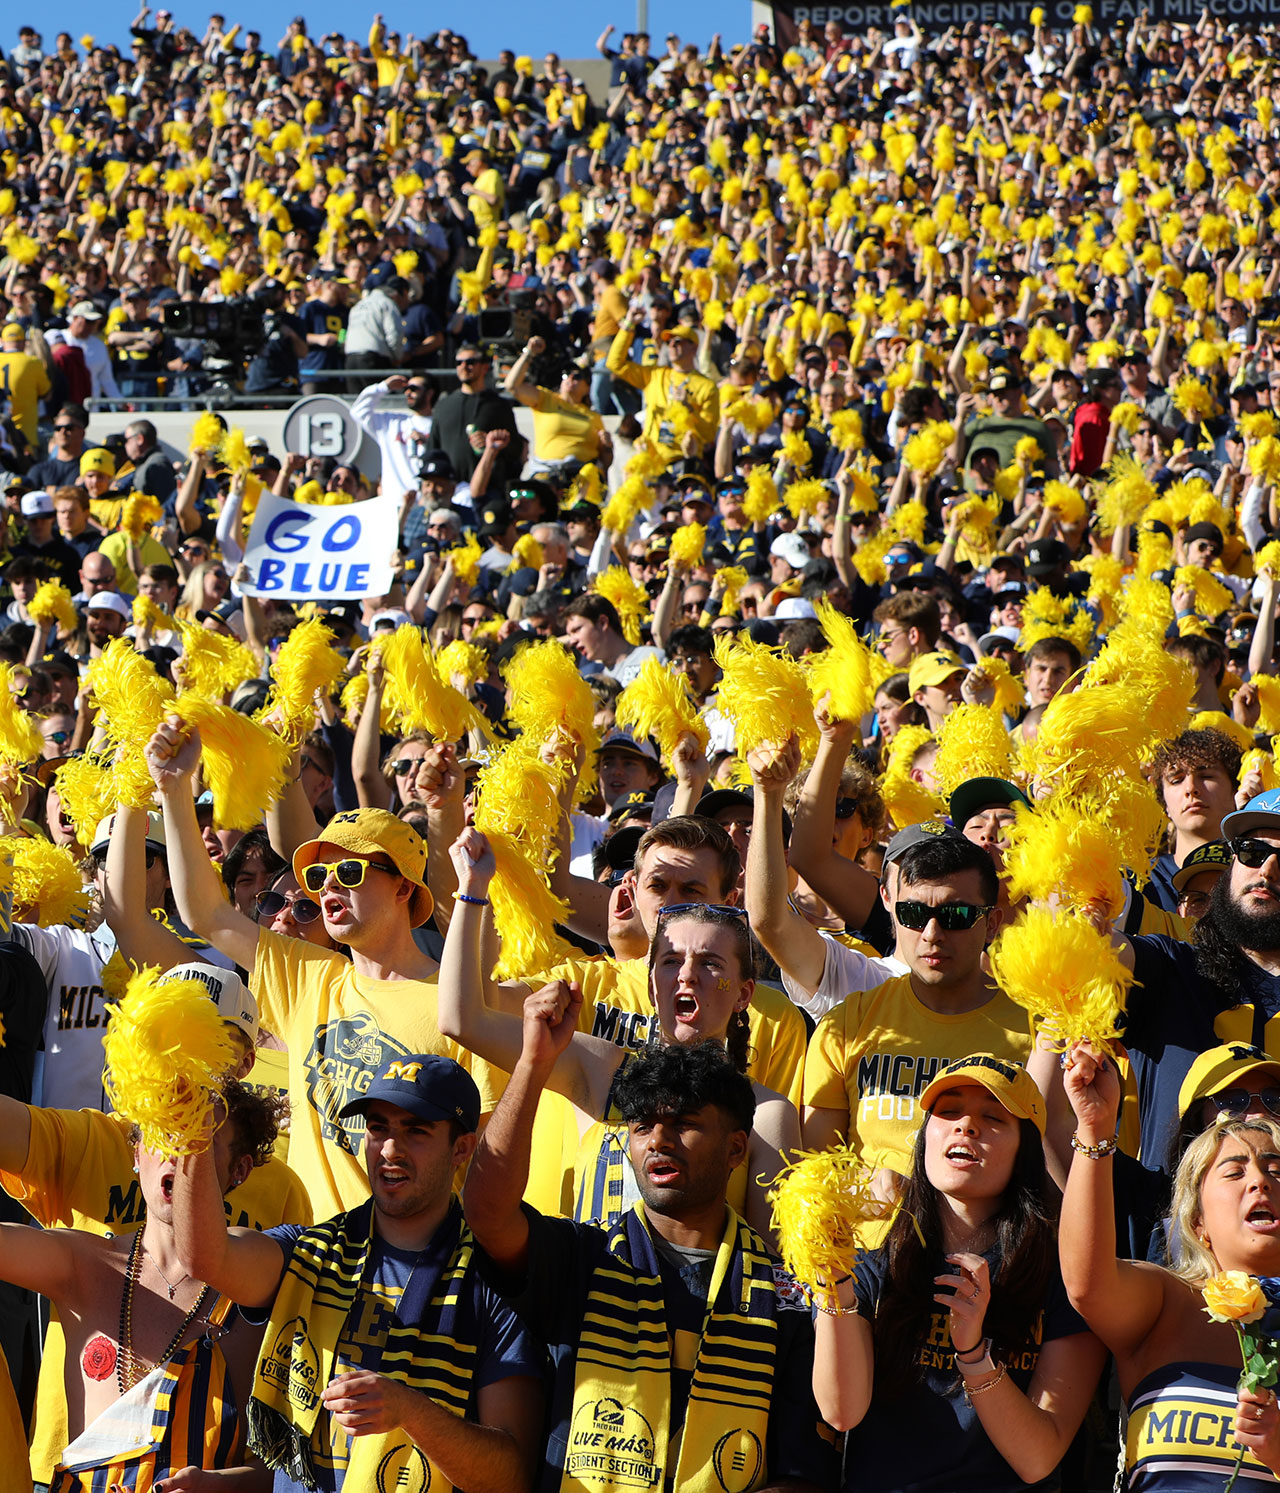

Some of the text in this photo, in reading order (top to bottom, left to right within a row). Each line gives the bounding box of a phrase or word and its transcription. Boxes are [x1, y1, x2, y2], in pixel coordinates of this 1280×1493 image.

[794, 5, 895, 25] REPORT
[1056, 1, 1093, 20] O
[1101, 0, 1154, 18] FAN
[298, 412, 344, 457] 13
[265, 510, 362, 553] GO
[256, 558, 371, 592] BLUE
[626, 793, 645, 804] M
[335, 813, 360, 823] M
[718, 978, 731, 991] M
[382, 1061, 424, 1083] M
[945, 1055, 1019, 1084] MICHIGAN
[862, 1094, 915, 1122] FOO
[573, 1431, 604, 1447] LIVE
[1146, 1410, 1250, 1452] MICH
[608, 1458, 653, 1479] SECTION
